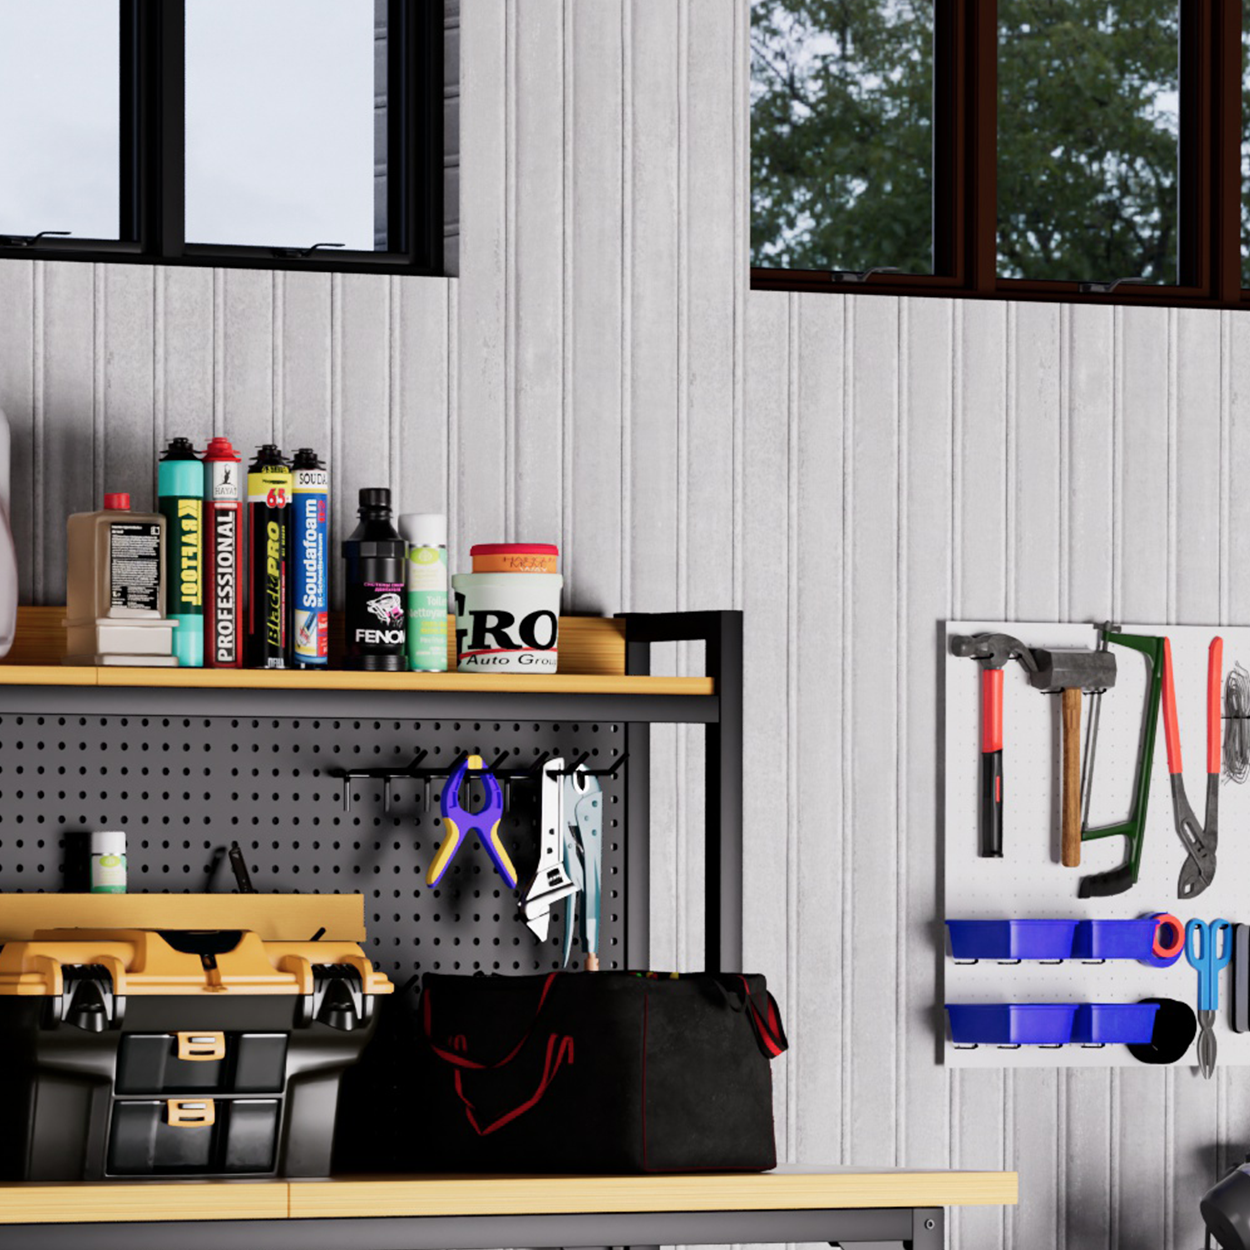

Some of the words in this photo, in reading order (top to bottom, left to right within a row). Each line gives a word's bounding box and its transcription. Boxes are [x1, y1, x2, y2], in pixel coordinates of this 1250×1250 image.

[217, 511, 234, 662] PROFESSIONAL
[303, 499, 317, 608] Soudafoam
[466, 654, 510, 665] Auto
